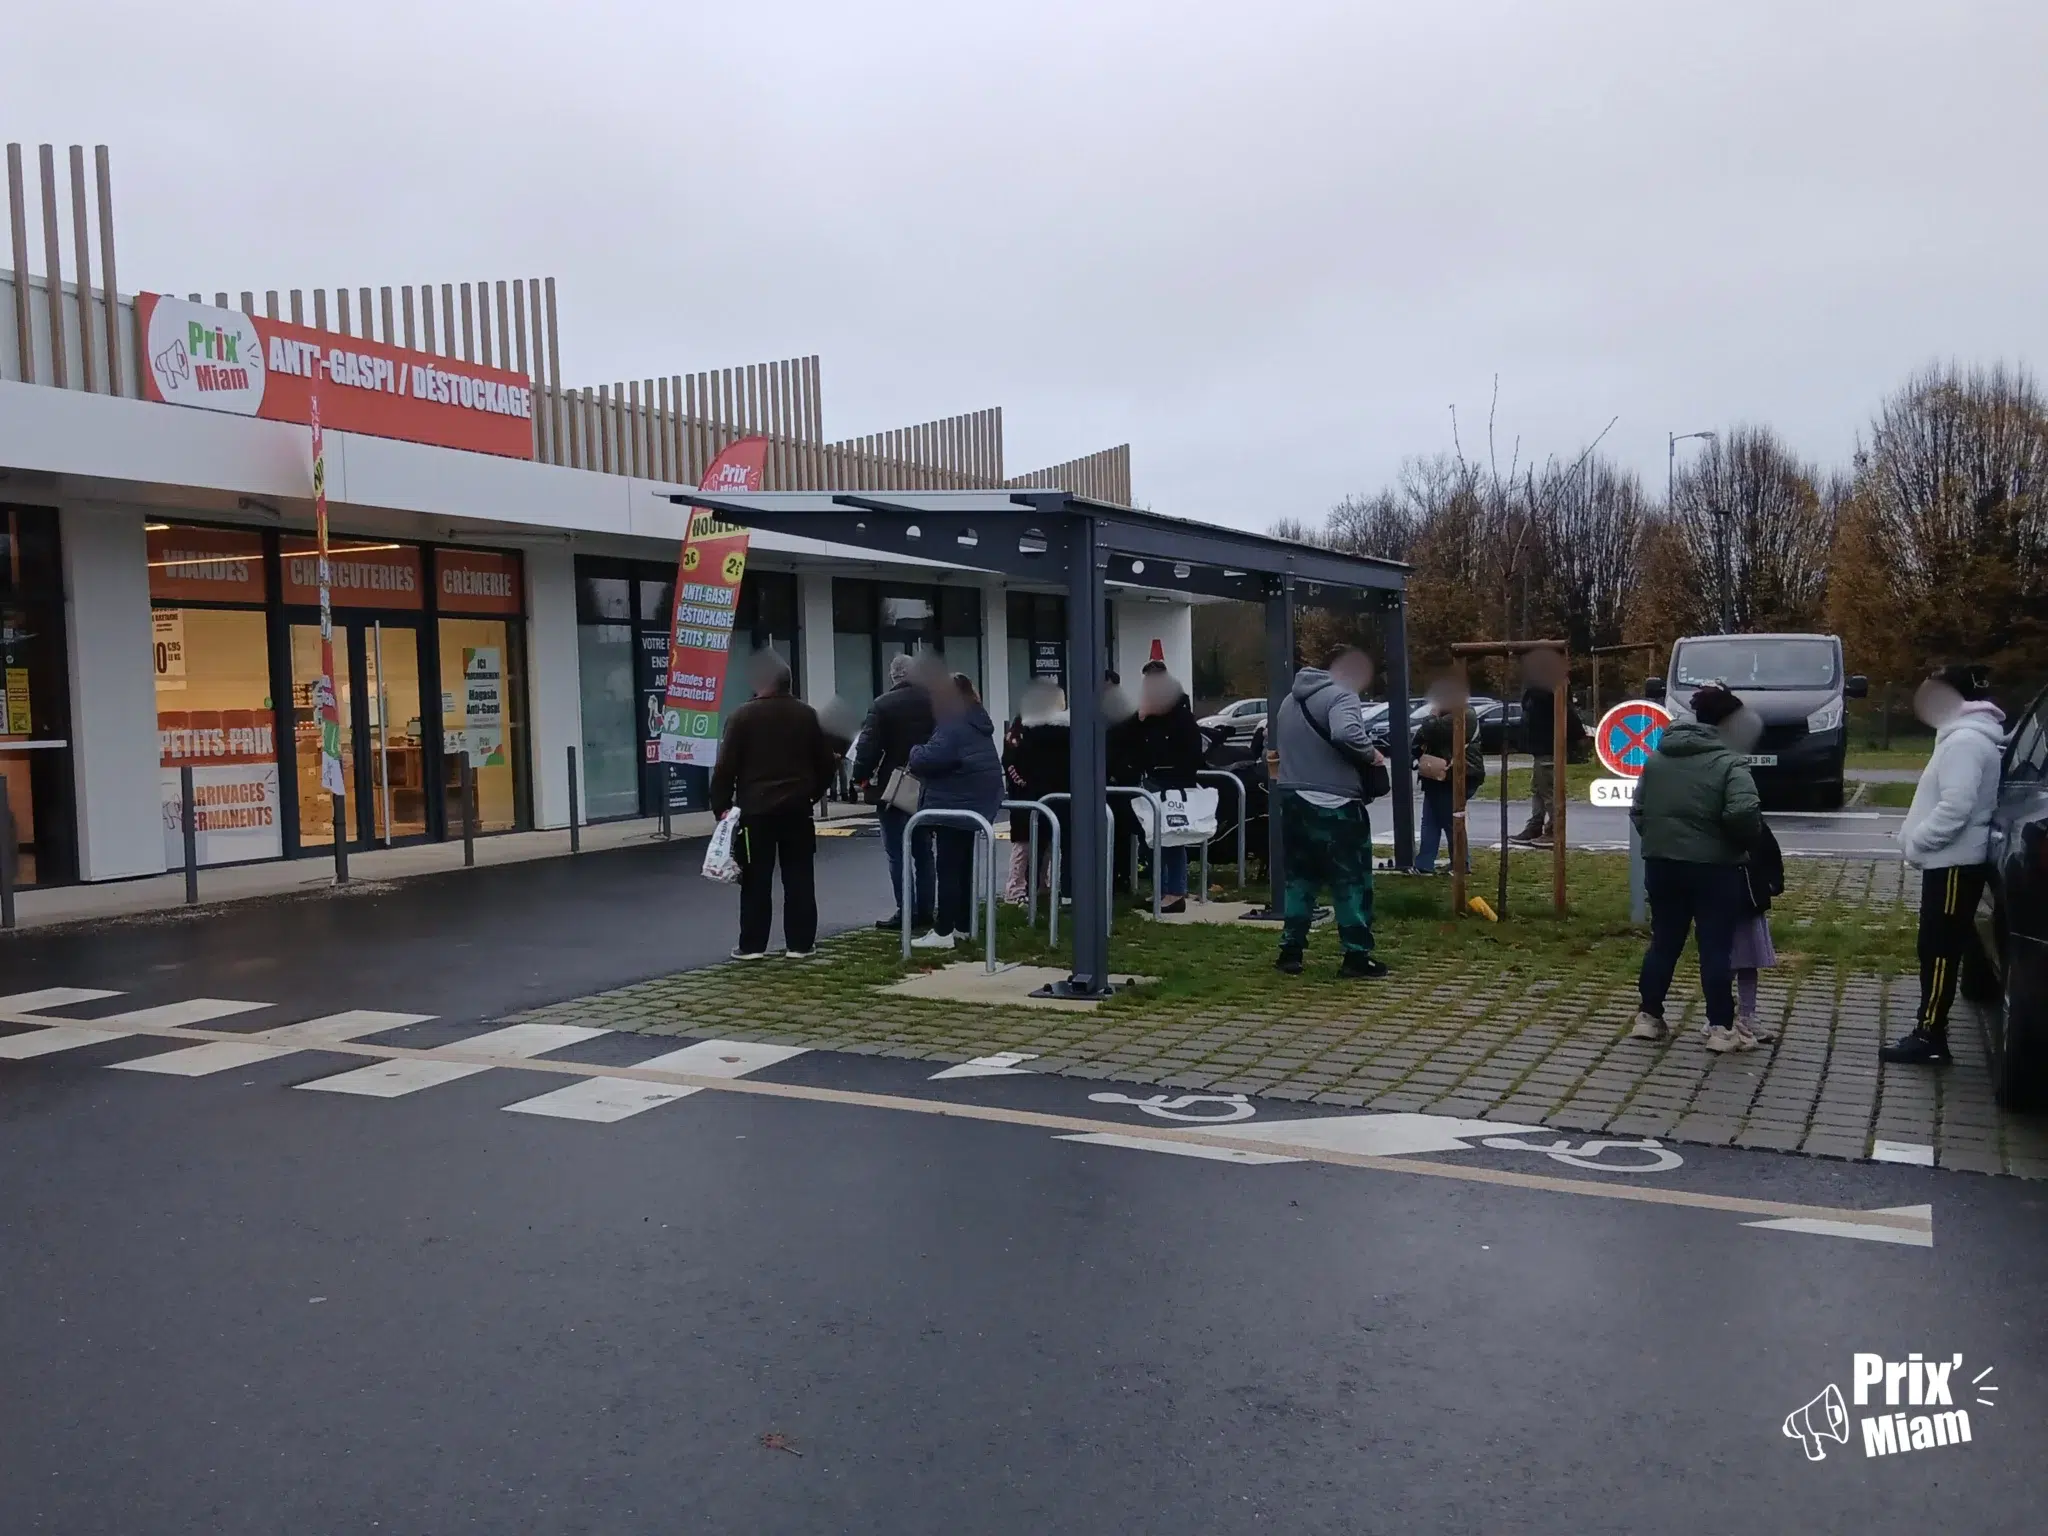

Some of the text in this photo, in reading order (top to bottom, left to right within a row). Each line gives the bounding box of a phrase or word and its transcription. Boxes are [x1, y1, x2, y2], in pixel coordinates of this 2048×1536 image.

[188, 320, 241, 363] Prix'
[195, 364, 249, 391] Miam
[412, 364, 531, 418] DÉSTOCKAGE
[162, 549, 249, 582] VIANDES
[442, 566, 512, 597] CRÈMERIE
[642, 637, 667, 650] VOTRE
[469, 689, 497, 702] Magasin
[705, 676, 716, 689] et
[160, 725, 274, 759] PETITS PRIX
